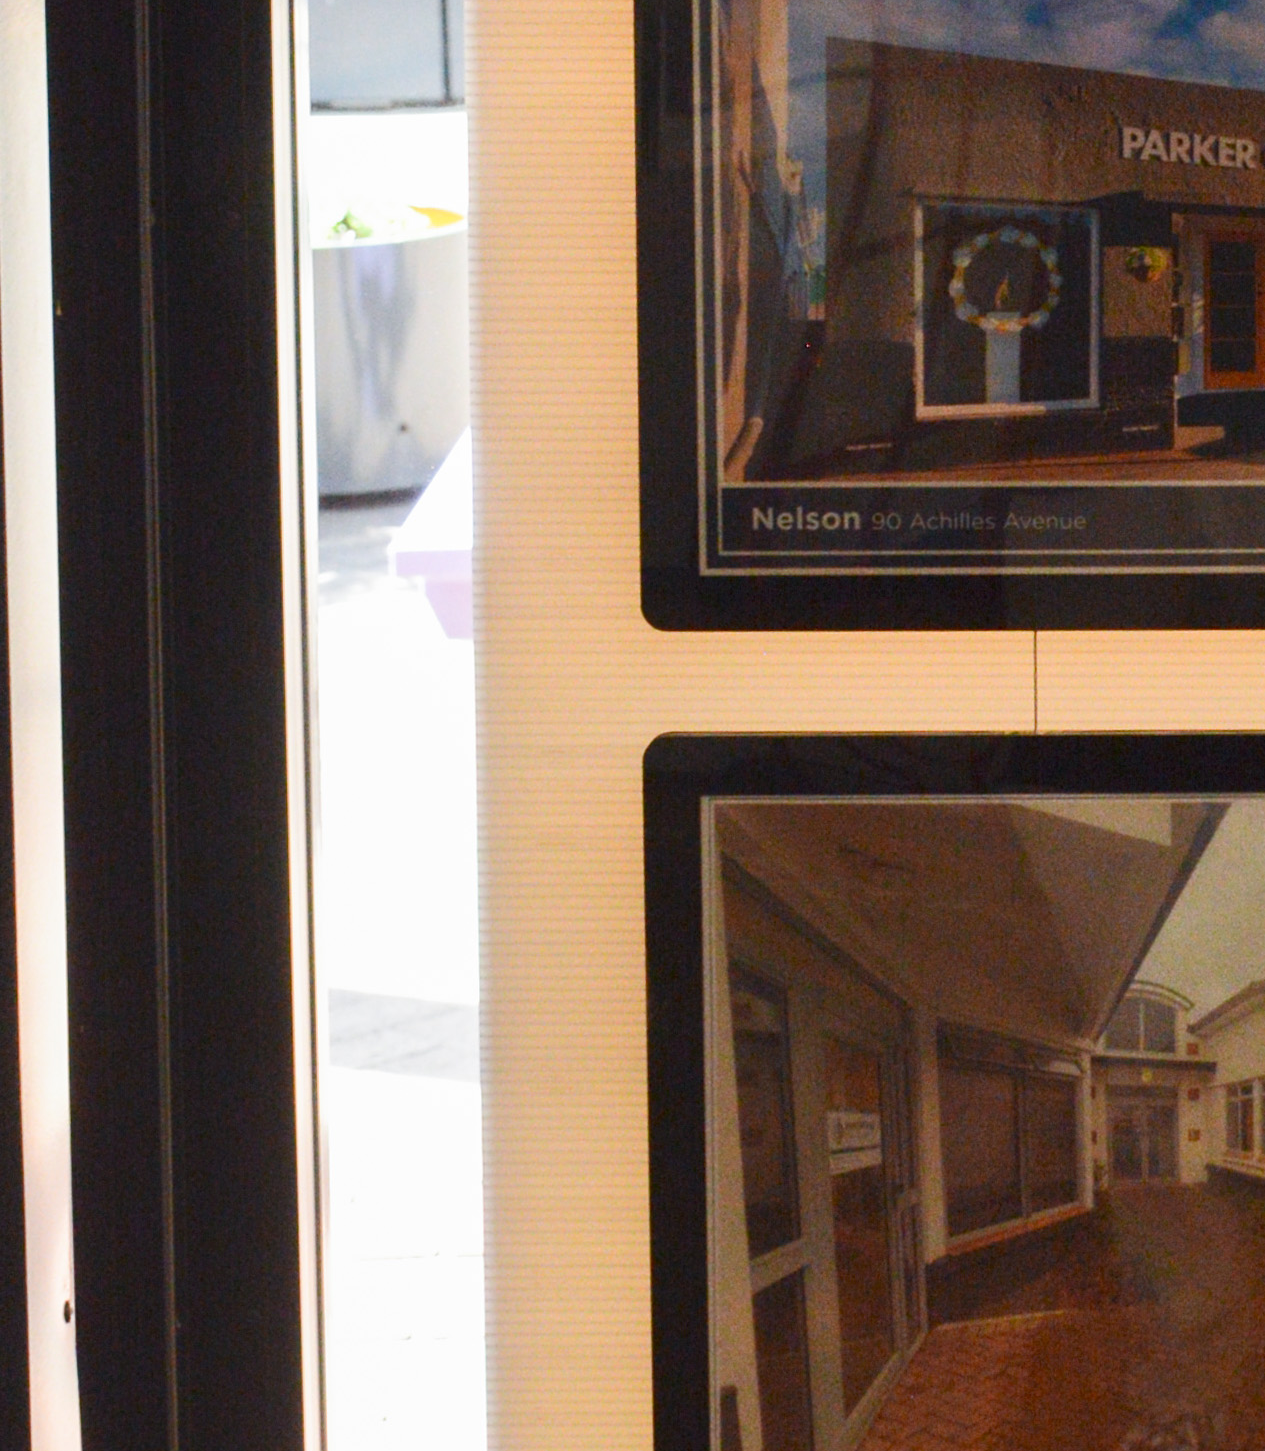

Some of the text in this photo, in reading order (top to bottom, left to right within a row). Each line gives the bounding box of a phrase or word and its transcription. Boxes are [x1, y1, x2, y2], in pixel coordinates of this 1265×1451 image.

[1122, 126, 1256, 169] PARKER
[752, 506, 1087, 531] Nelson 90 Achilles Avenue
